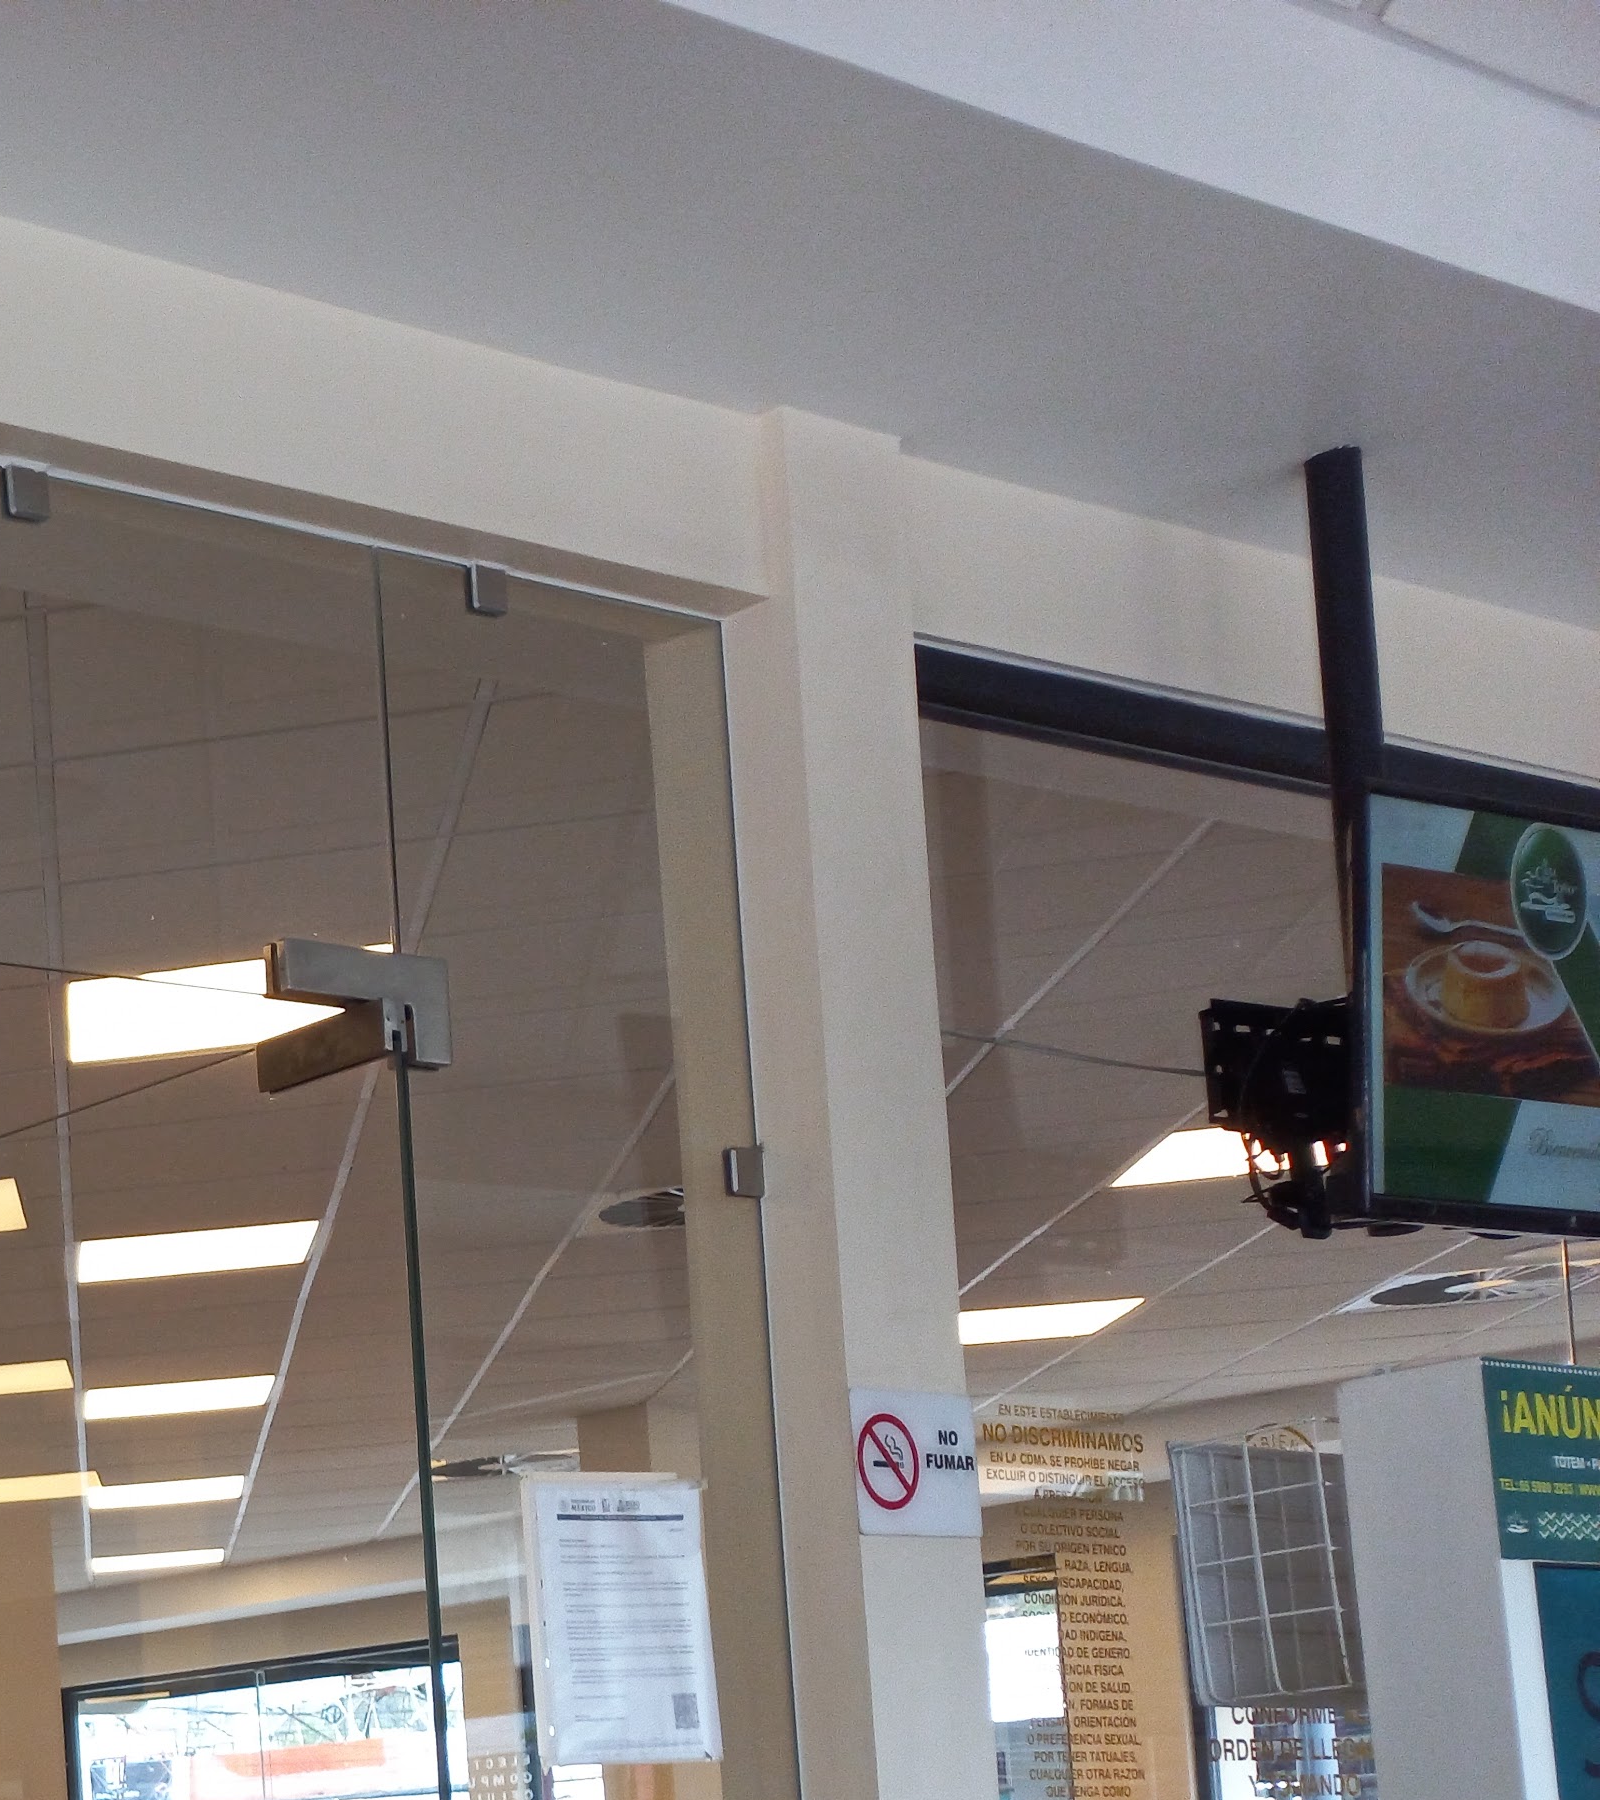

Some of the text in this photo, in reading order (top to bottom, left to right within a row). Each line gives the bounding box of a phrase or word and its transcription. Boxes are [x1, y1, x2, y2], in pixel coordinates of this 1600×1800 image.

[998, 1404, 1124, 1424] EN ESTE ESTABLECIMIENTO
[937, 1430, 958, 1446] NO
[983, 1423, 1143, 1453] NO DISCRIMINAMOS
[926, 1453, 974, 1471] FUMAR
[990, 1451, 1003, 1463] EN
[1006, 1453, 1016, 1463] LA
[1020, 1453, 1048, 1466] CDMX
[1050, 1455, 1062, 1467] SE
[986, 1469, 1025, 1482] EXCLUIR
[1029, 1471, 1035, 1482] O
[1039, 1471, 1092, 1486] DISTINGUIR
[1094, 1475, 1105, 1487] EL
[1080, 1509, 1123, 1521] PERSONA
[1031, 1523, 1083, 1537] COLECTIVO
[1054, 1542, 1089, 1554] ORIGEN
[1076, 1647, 1089, 1658] DE
[1086, 1682, 1098, 1693] DE
[1081, 1699, 1118, 1710] FORMAS
[1122, 1699, 1133, 1710] DE
[1028, 1734, 1034, 1744] O
[1037, 1734, 1102, 1745] PREFERENCIA
[1209, 1738, 1274, 1762] ORDEN
[1034, 1751, 1054, 1762] POR
[1086, 1769, 1112, 1779] OTRA
[1046, 1786, 1131, 1797] QUE ENGA COMO
